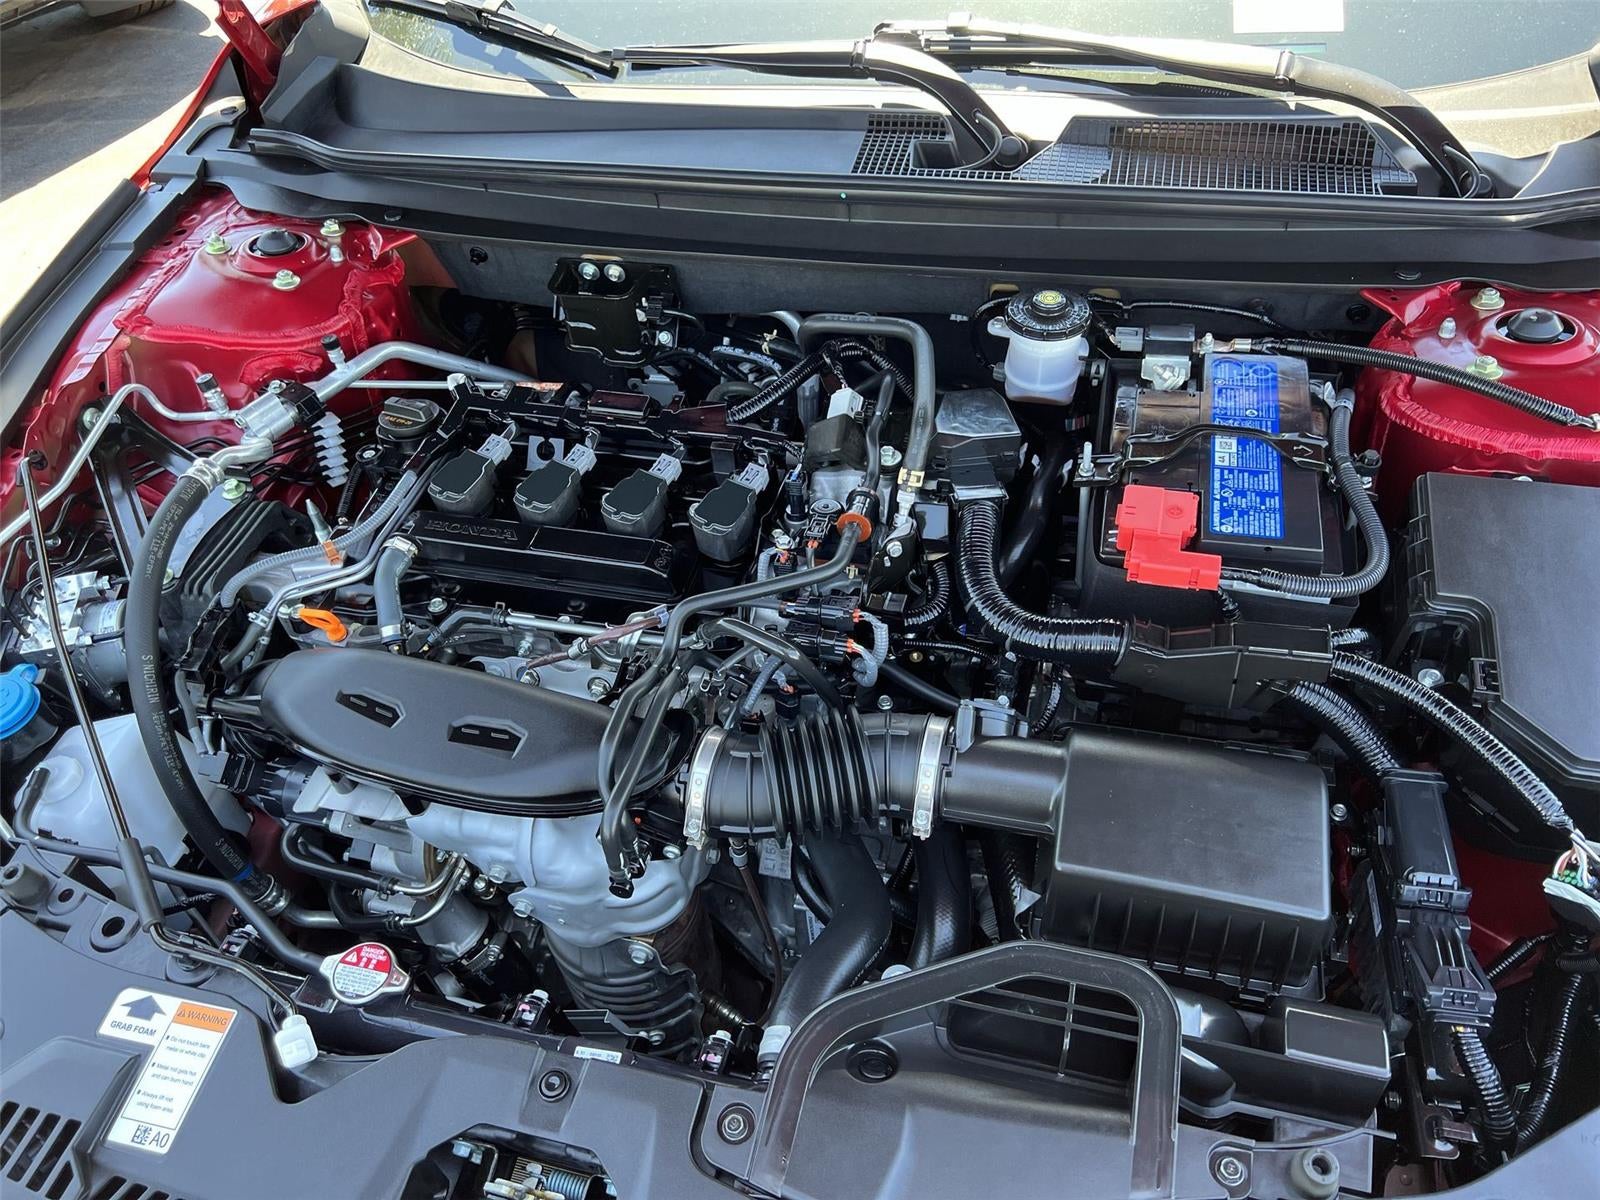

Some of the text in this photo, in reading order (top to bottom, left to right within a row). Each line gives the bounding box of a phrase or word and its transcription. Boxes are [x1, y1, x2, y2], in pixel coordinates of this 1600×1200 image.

[424, 520, 519, 541] HONDA
[187, 1010, 228, 1026] WARNING
[110, 1019, 157, 1037] GRAB FOAM
[149, 1132, 171, 1149] A0
